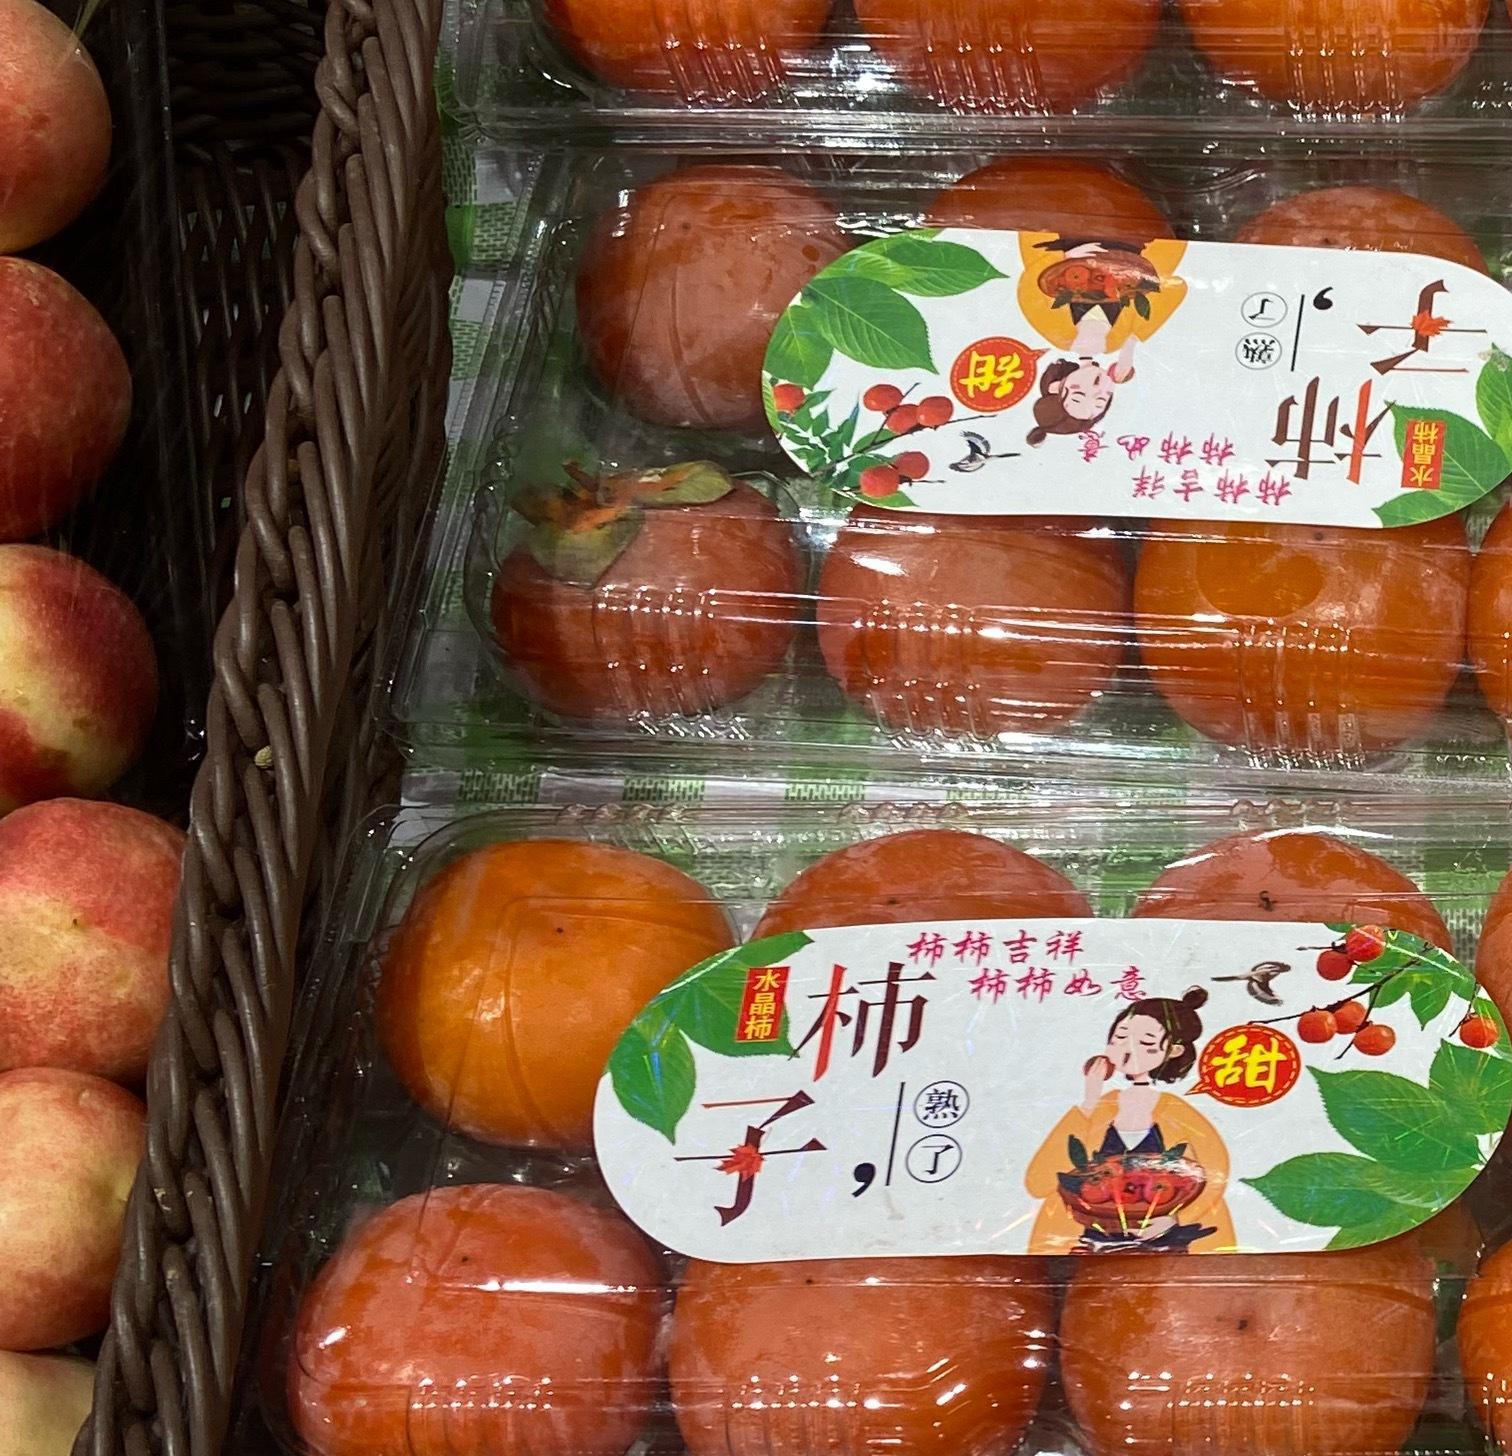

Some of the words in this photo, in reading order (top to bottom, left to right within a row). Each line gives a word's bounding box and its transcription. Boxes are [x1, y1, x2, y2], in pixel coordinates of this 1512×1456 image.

[959, 349, 1025, 398] 甜
[1077, 429, 1236, 467] 柿柿如意
[1409, 421, 1440, 487] 水晶柿
[1131, 465, 1293, 506] 柿柿吉祥
[906, 929, 1085, 967] 柿柿吉祥
[744, 969, 782, 1041] 水晶柿
[968, 965, 1148, 1002] 柿柿如意
[1210, 1033, 1288, 1095] 甜
